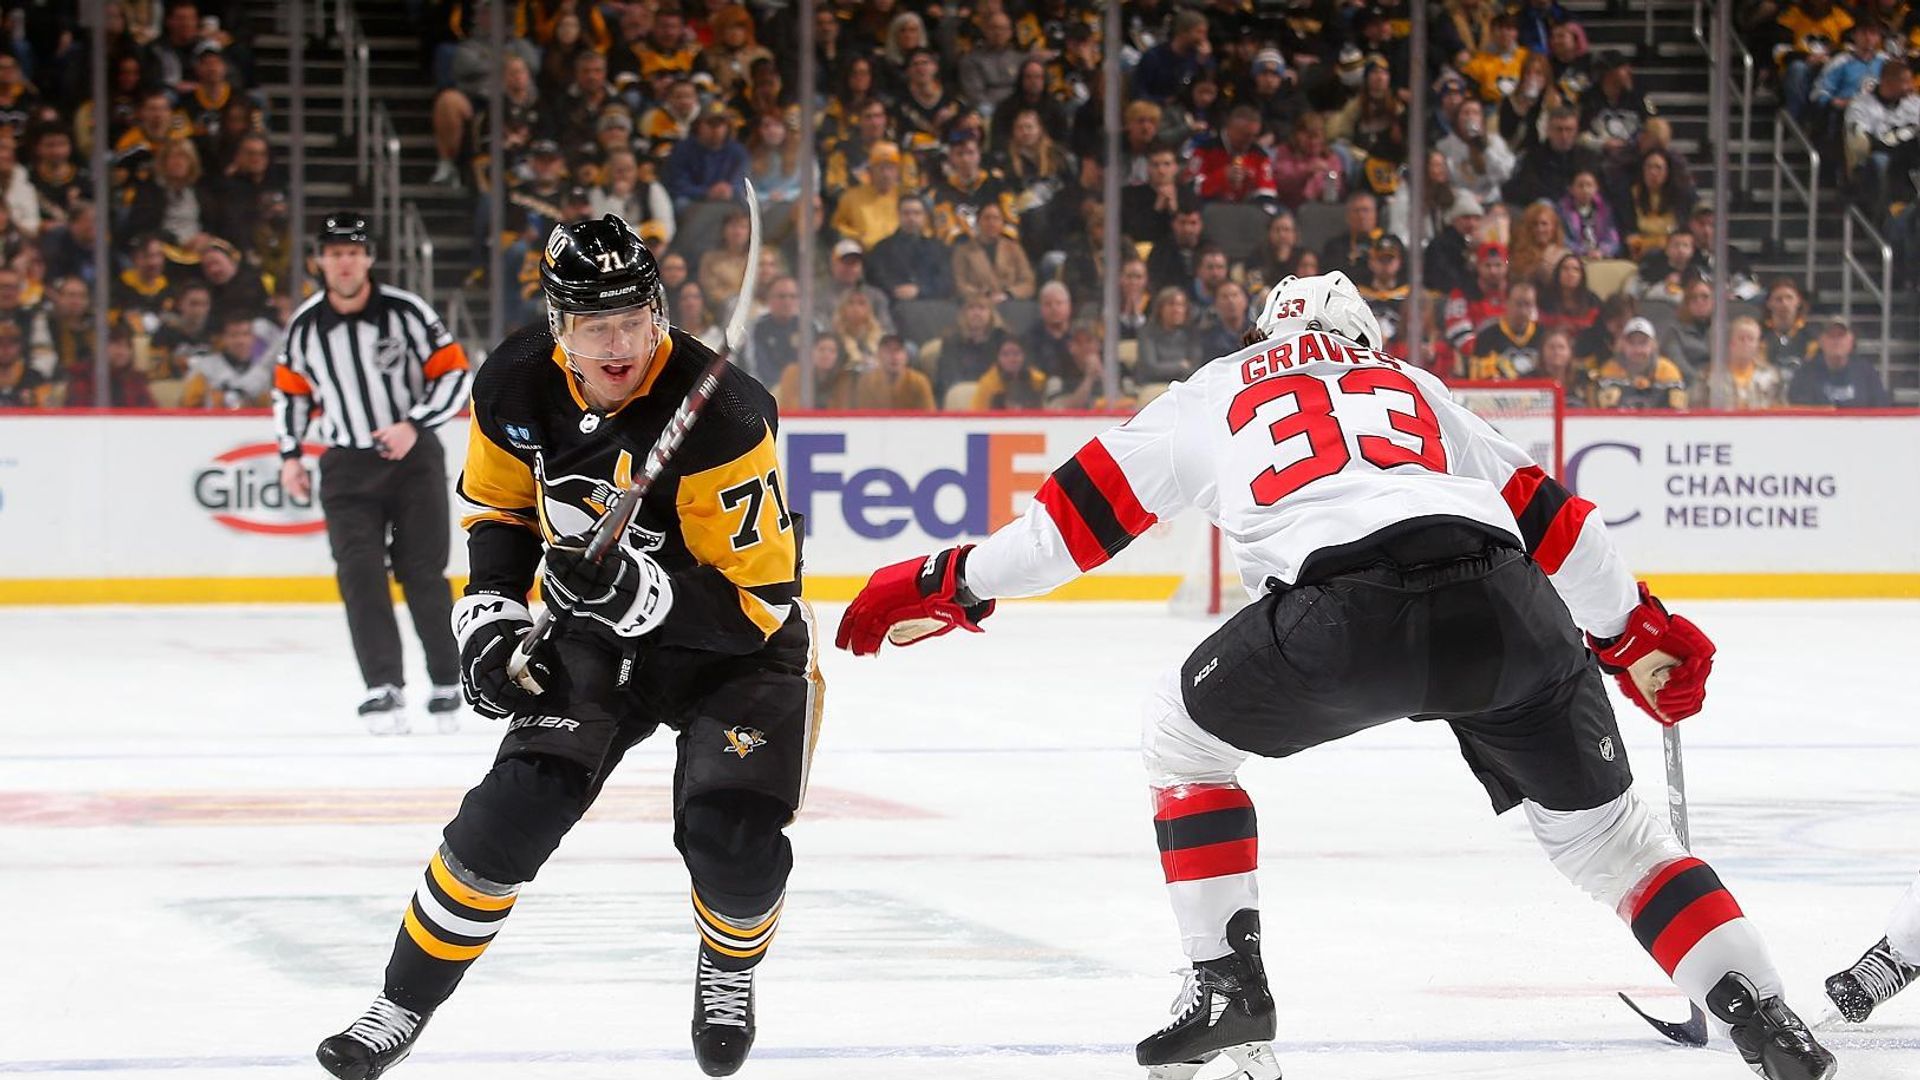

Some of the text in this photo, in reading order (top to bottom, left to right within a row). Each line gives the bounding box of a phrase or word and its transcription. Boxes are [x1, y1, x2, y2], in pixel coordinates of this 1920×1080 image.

[595, 251, 625, 273] 71
[1276, 298, 1306, 319] 33
[1226, 366, 1449, 507] 33
[1666, 443, 1733, 466] LIFE
[787, 433, 1046, 540] FedE
[1666, 474, 1837, 498] CHANGING
[717, 469, 792, 552] 71
[1666, 506, 1820, 529] MEDICINE
[1193, 656, 1219, 688] CCM
